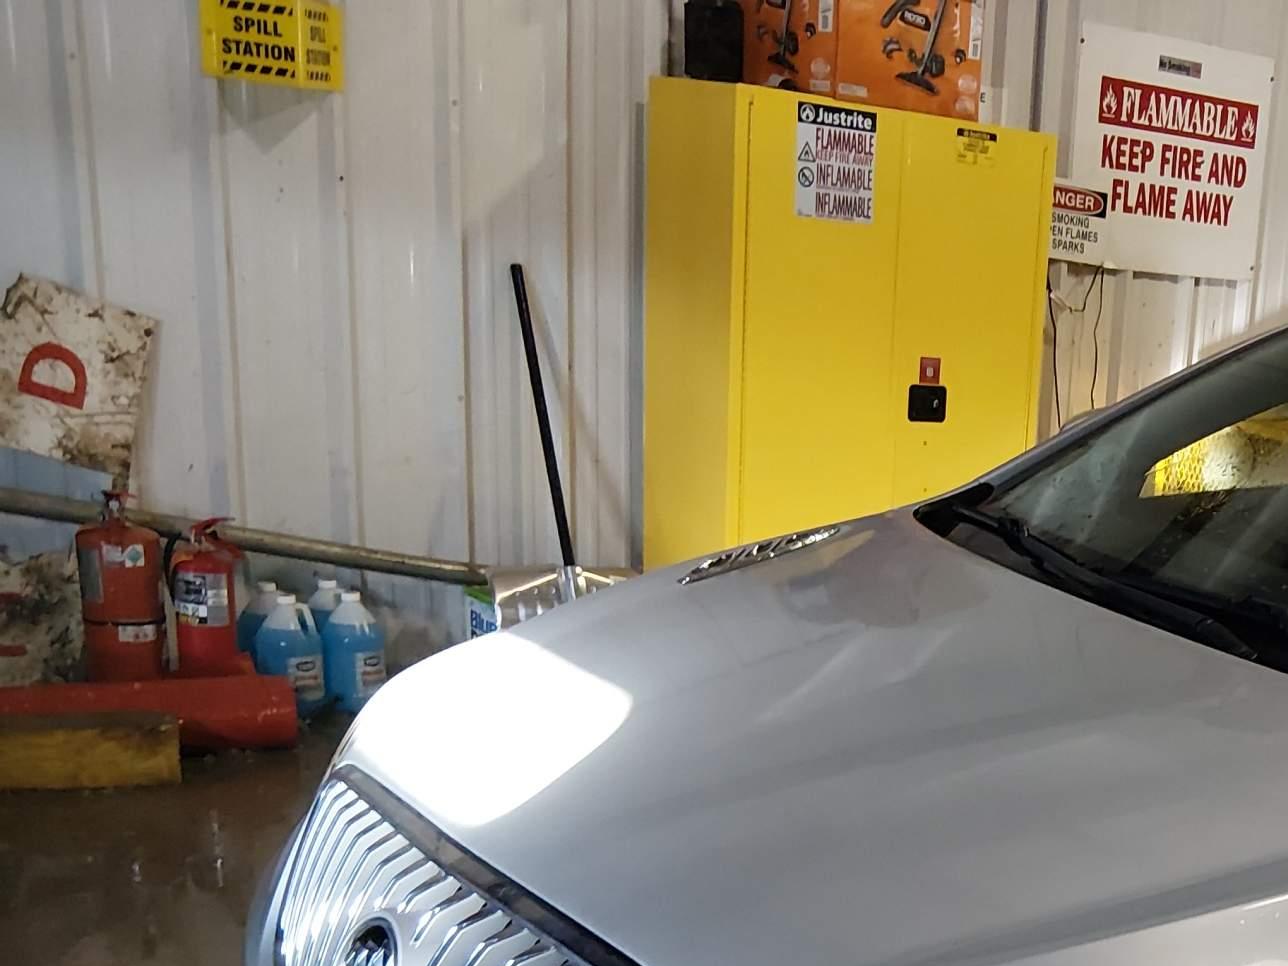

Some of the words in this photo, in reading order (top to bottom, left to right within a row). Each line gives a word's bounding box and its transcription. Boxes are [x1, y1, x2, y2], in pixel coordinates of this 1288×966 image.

[233, 15, 283, 38] SPILL
[222, 37, 296, 63] STATION
[816, 107, 873, 130] Justrite
[1120, 86, 1239, 141] FLAMMABLE
[815, 127, 874, 156] FLAMMABLE
[1101, 134, 1155, 174] KEEP
[1159, 143, 1205, 182] FIRE
[1207, 152, 1248, 189] AND
[816, 163, 873, 191] INFLAMABLE
[815, 191, 873, 219] INFLAMMABLE
[1055, 190, 1095, 211] NGER
[1110, 178, 1178, 220] FLAME
[1182, 189, 1235, 227] AWAY
[1051, 225, 1064, 238] EN
[1065, 226, 1098, 243] FLAMES
[1052, 212, 1090, 229] SMOKING
[1052, 238, 1085, 254] SPARKS
[17, 340, 88, 411] D
